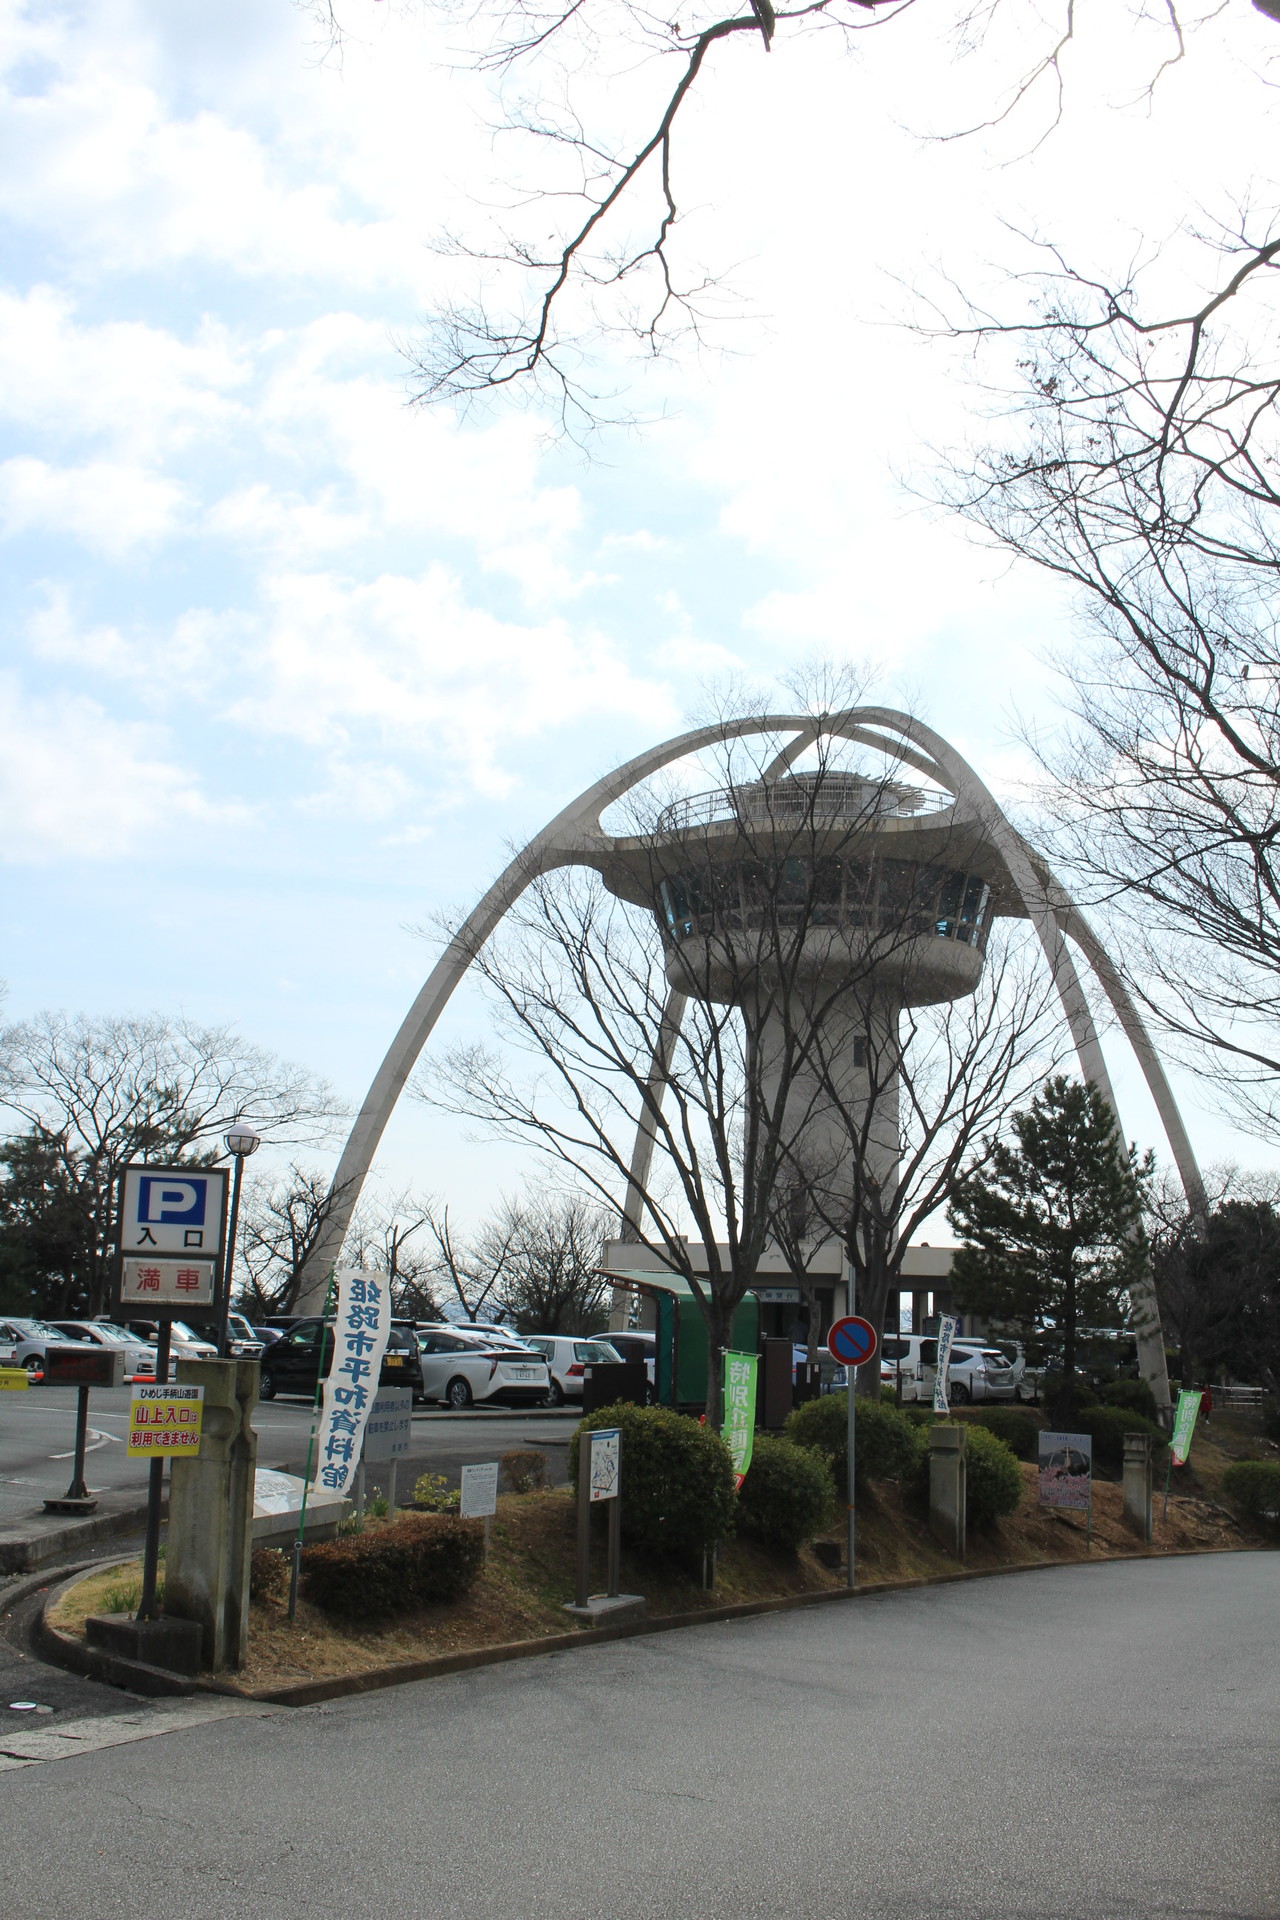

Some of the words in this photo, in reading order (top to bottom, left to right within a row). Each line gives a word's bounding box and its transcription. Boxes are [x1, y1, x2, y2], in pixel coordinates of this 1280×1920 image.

[148, 1180, 198, 1221] P
[137, 1227, 204, 1248] 入口
[137, 1268, 201, 1293] 満車
[140, 1388, 199, 1399] ひめじ手柄山遊園
[135, 1406, 199, 1424] 山上入口は
[370, 1400, 410, 1413] 園利用者以外の
[130, 1432, 199, 1447] 利用できません
